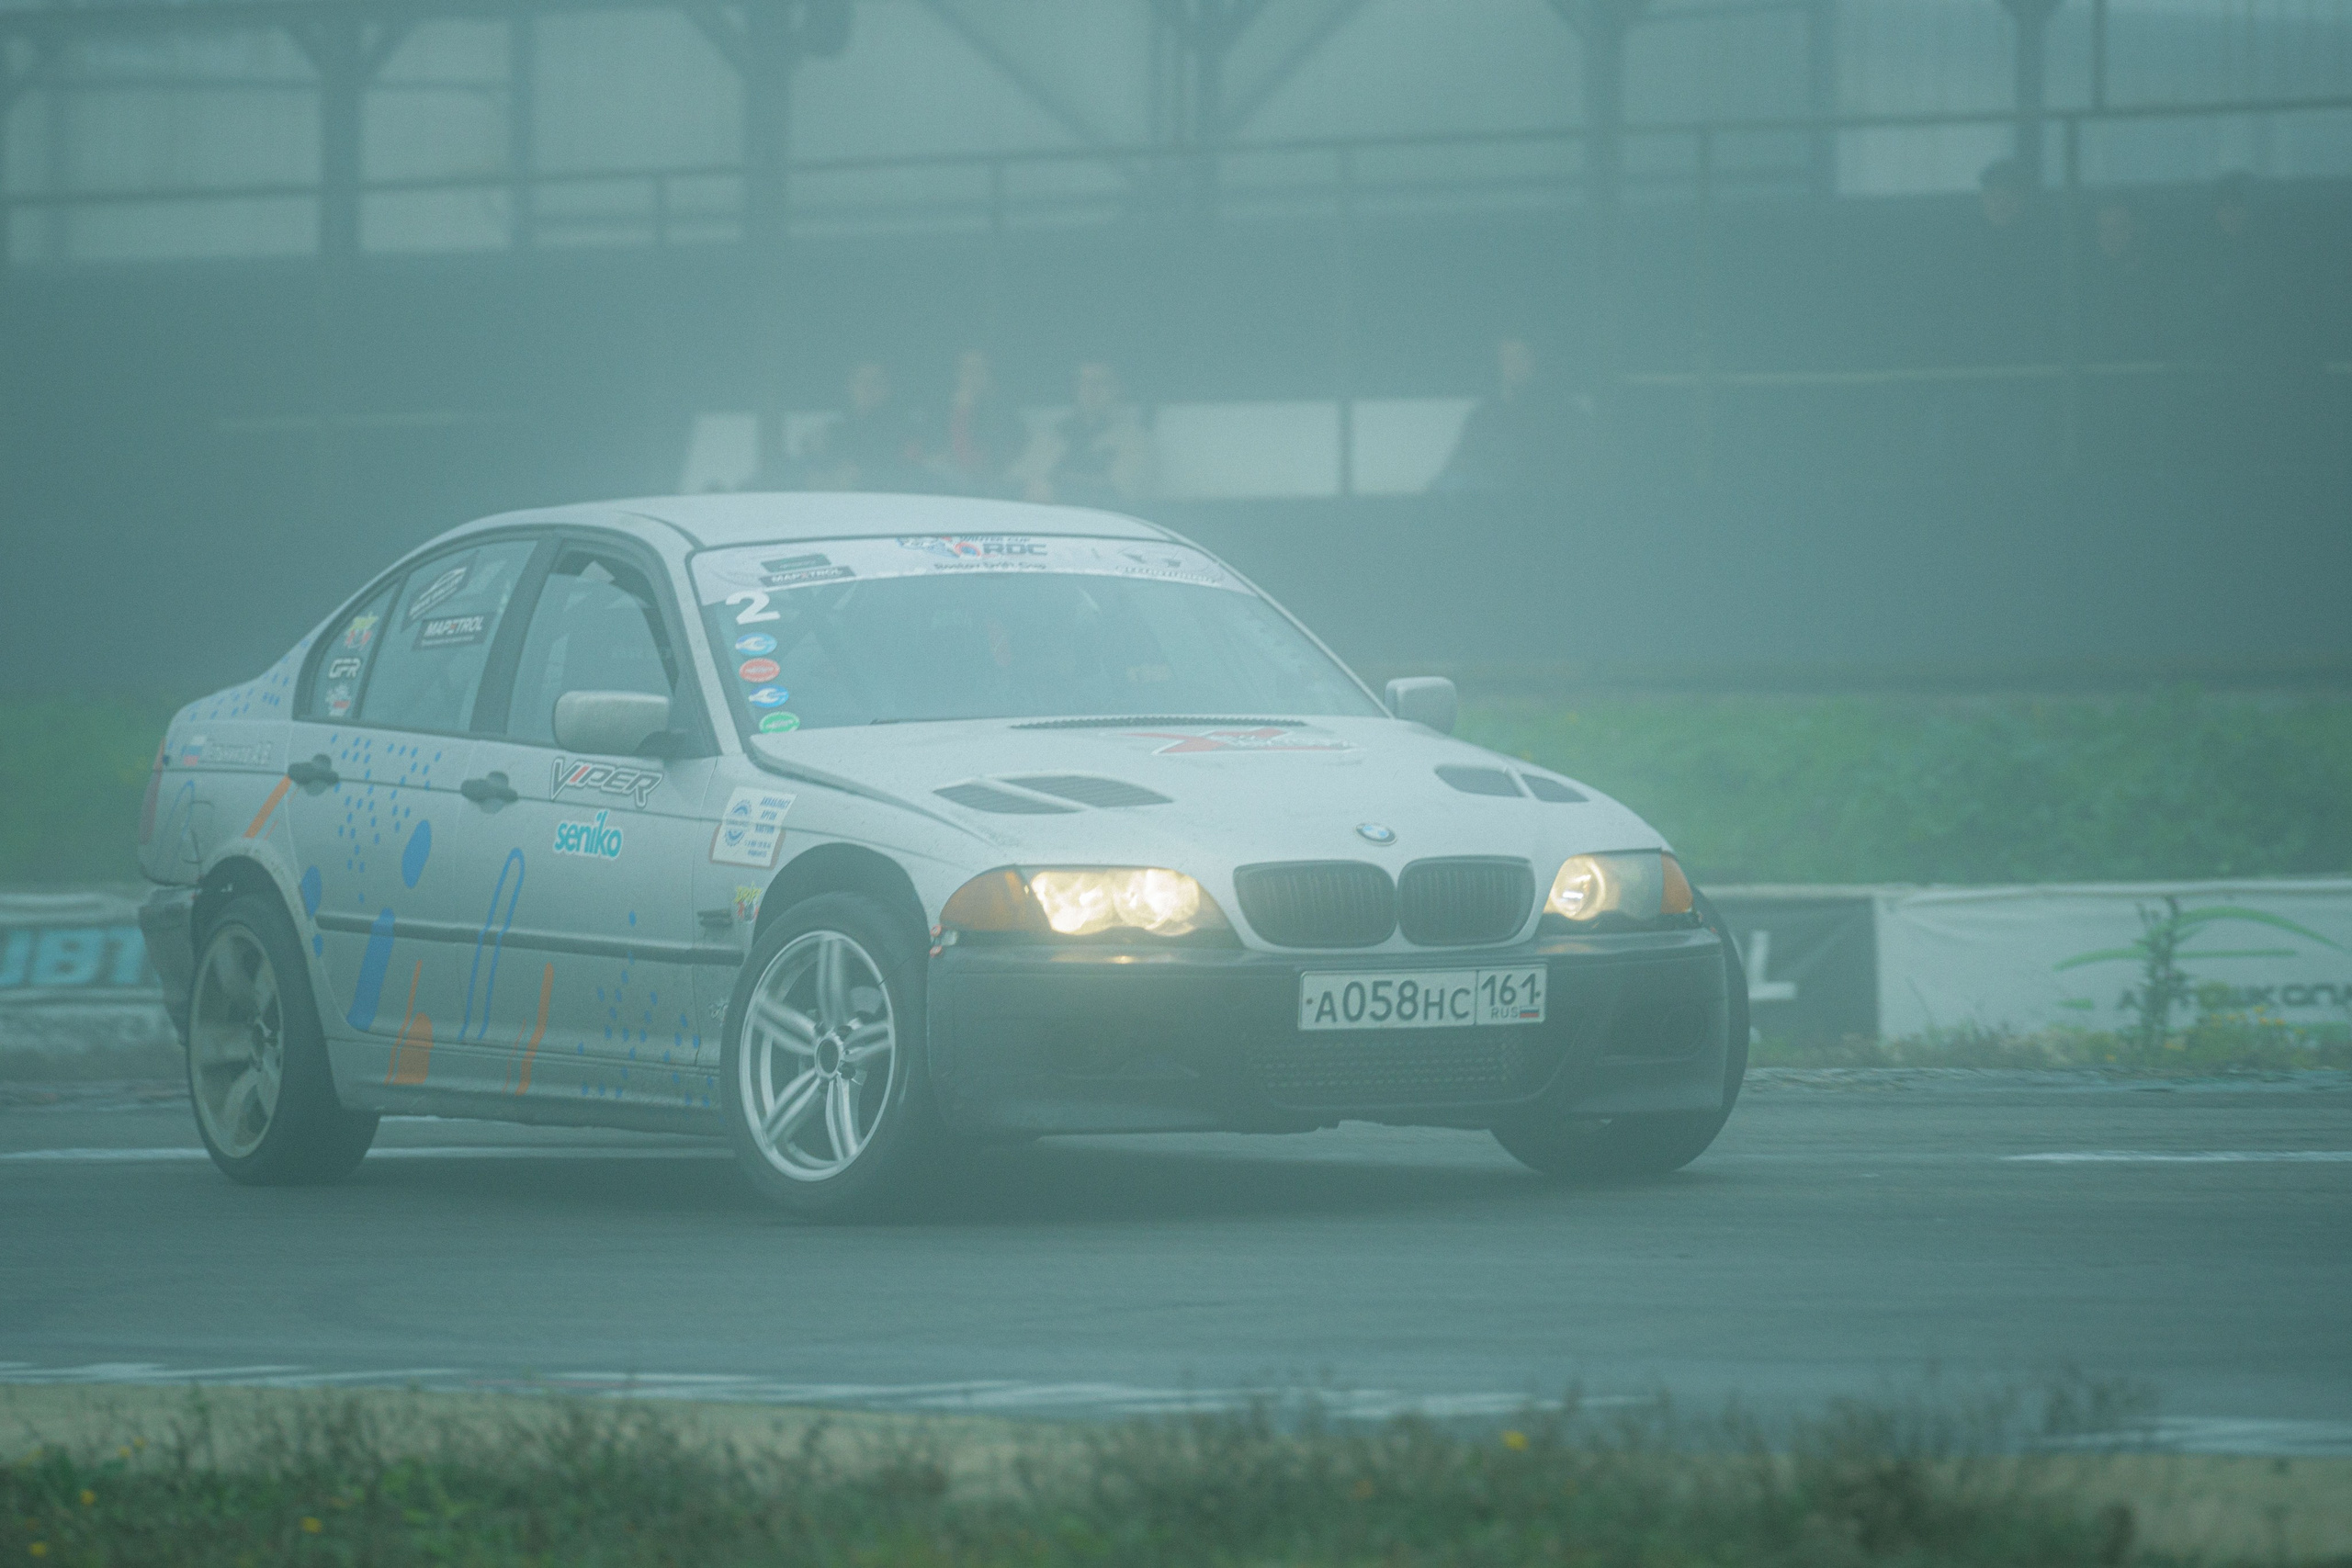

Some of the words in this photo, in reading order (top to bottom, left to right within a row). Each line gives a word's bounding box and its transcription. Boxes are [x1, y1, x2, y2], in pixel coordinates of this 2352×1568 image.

[982, 543, 1048, 556] RDC
[725, 589, 781, 625] 2
[550, 757, 663, 807] VIPER
[554, 809, 623, 859] seniko
[1481, 973, 1537, 1006] 161
[1490, 1007, 1519, 1019] RUS
